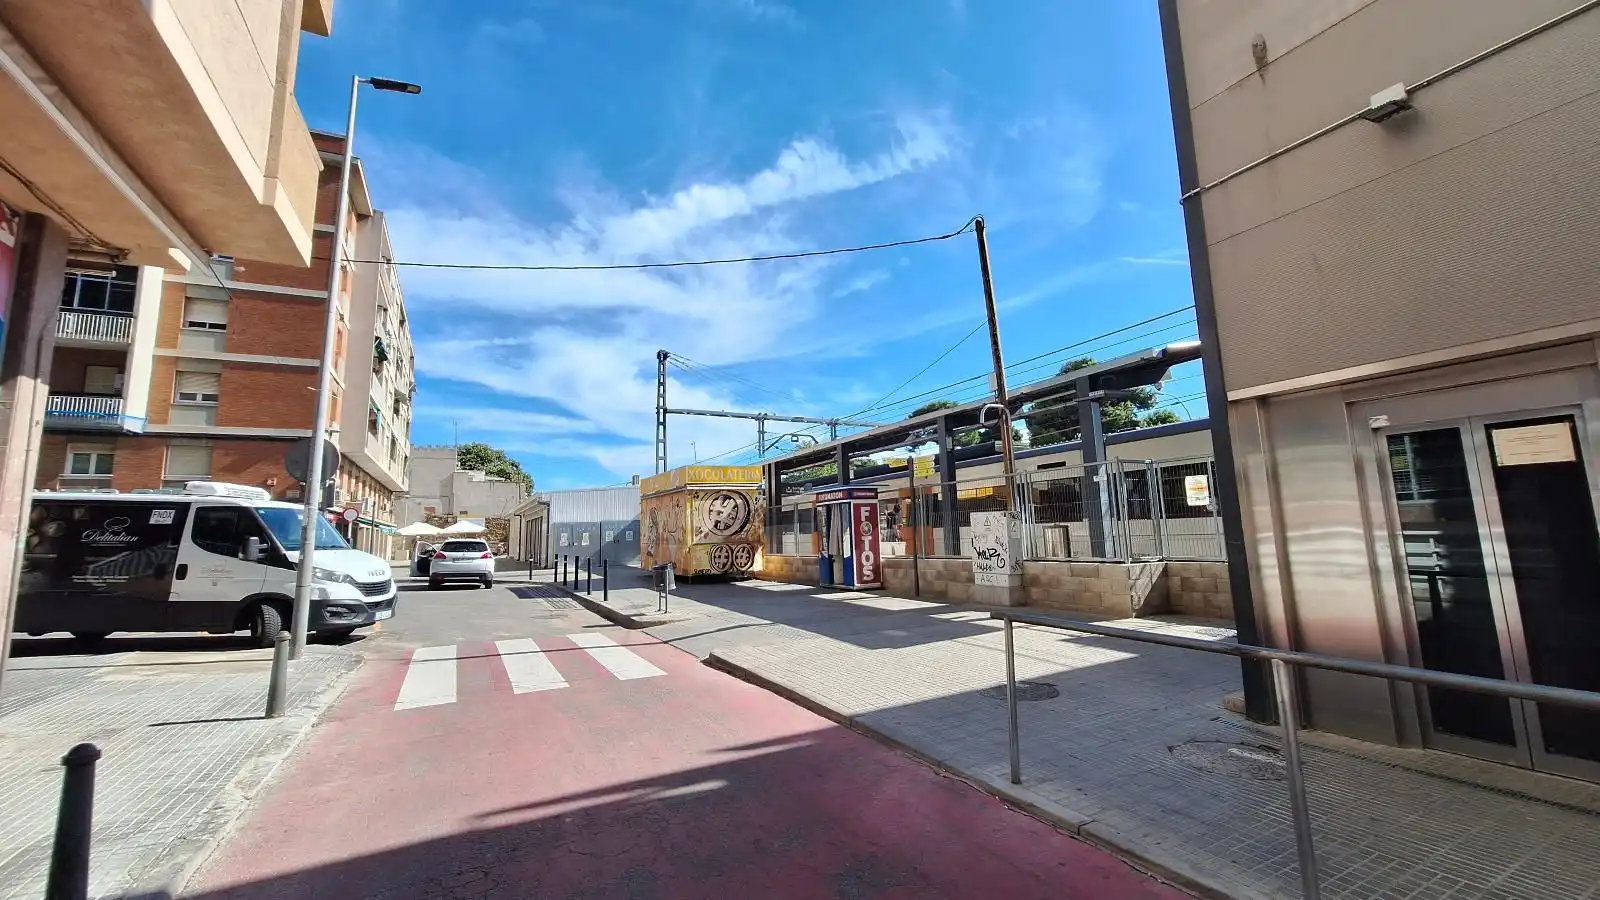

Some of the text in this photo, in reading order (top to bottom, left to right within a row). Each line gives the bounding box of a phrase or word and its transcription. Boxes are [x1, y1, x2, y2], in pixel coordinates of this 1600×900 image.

[689, 468, 760, 481] XOCOLATERIA
[152, 510, 174, 519] FNDX
[80, 529, 139, 542] Delitalian
[860, 506, 874, 581] FOTOS
